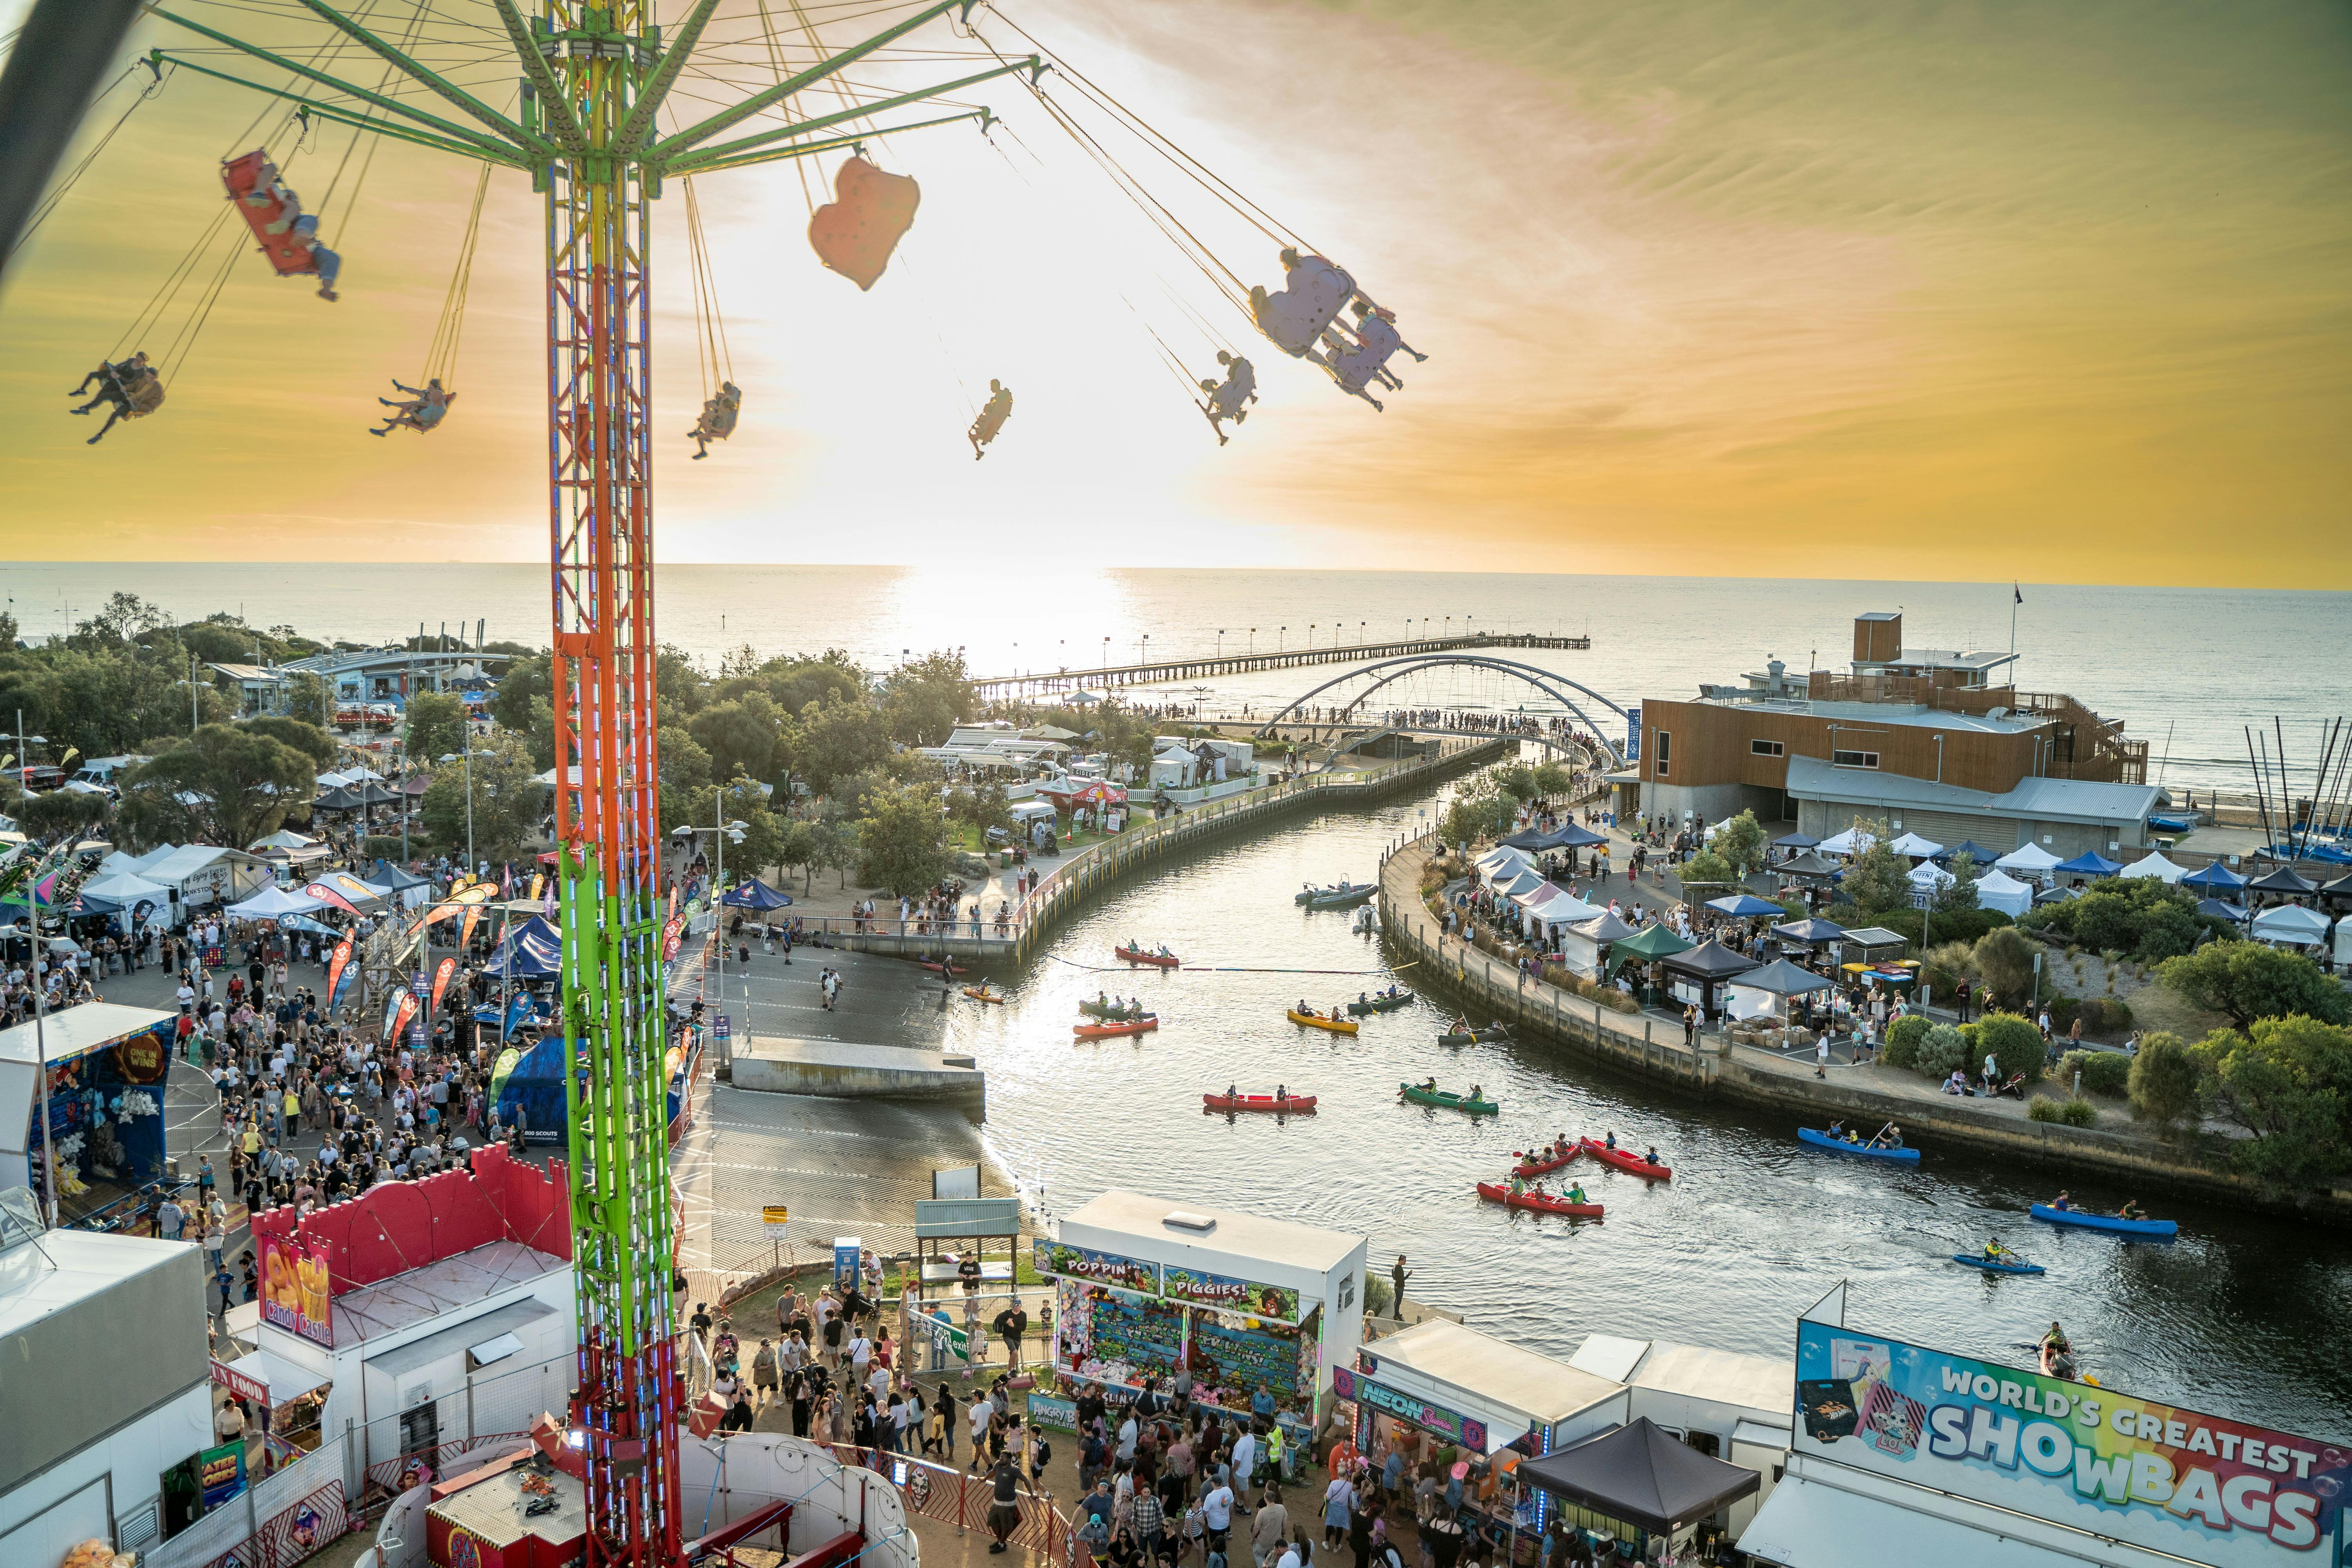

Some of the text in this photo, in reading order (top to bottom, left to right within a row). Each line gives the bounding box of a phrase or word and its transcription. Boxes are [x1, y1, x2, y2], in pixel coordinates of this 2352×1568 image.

[193, 871, 208, 883] Enjoy
[131, 1049, 147, 1057] ONE
[131, 1057, 156, 1068] WINS
[1067, 1260, 1132, 1275] POPPIN'
[1176, 1281, 1247, 1296] PIGGIES!
[266, 1299, 332, 1346] Candy Castle
[953, 1340, 967, 1353] exit
[211, 1363, 263, 1401] UN FOOD
[1033, 1403, 1066, 1421] ANGRY
[1362, 1382, 1454, 1432] NEON Slushie
[1036, 1416, 1077, 1430] EVERY PLAYER
[1941, 1366, 2316, 1480] WORLD'S GREATEST
[201, 1455, 237, 1475] ATER
[202, 1466, 238, 1488] ORKS
[1929, 1405, 2320, 1550] SHOWBAGS
[452, 1533, 476, 1556] SKY
